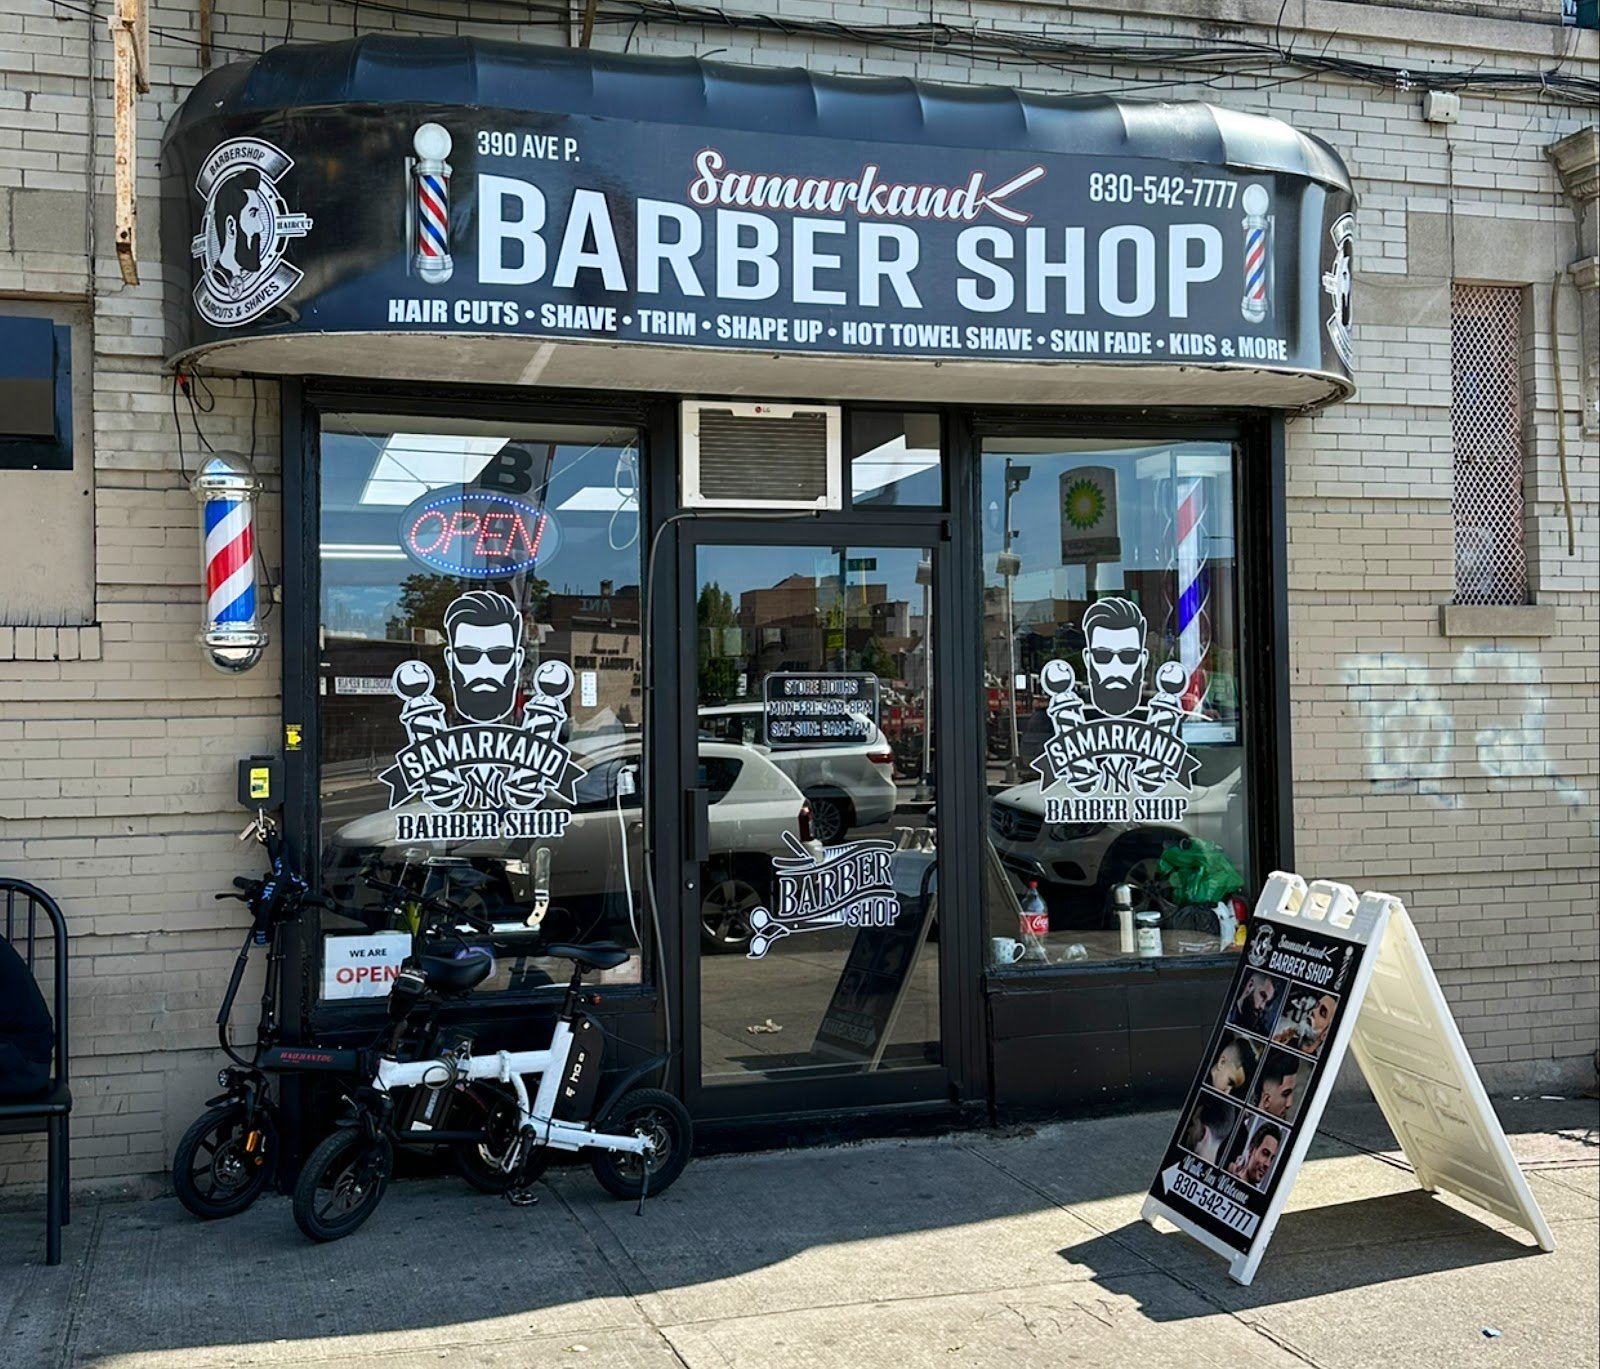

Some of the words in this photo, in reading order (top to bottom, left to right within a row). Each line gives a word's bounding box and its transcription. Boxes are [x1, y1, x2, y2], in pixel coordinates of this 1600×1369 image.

[209, 147, 265, 176] BARBERSHOP
[478, 130, 517, 157] 390
[522, 134, 559, 160] AVE
[564, 137, 580, 162] P.
[688, 150, 986, 220] Samarkand
[1089, 172, 1239, 209] 830-542-7777
[276, 220, 312, 230] HAIRCUT
[478, 173, 923, 309] BARBER
[955, 223, 1223, 319] SHOP
[235, 306, 242, 317] &
[244, 281, 280, 314] SHAVES
[388, 299, 448, 323] HAIR
[454, 300, 519, 326] CUTS
[540, 304, 617, 332] SHAVE
[637, 309, 697, 336] TRIM
[716, 314, 789, 342] SHAPE
[793, 317, 823, 343] UP
[842, 322, 886, 346] HOT
[890, 323, 962, 349] TOWEL
[966, 325, 1032, 350] SHAVE
[1050, 329, 1100, 353] SKIN
[1103, 330, 1152, 354] FADE
[1169, 333, 1216, 357] KIDS
[1220, 338, 1236, 357] &
[1238, 337, 1289, 361] MORE
[410, 510, 548, 557] OPEN
[784, 679, 820, 695] STORE
[820, 679, 859, 695] HOURS
[402, 731, 563, 779] SAMARKAND
[1051, 724, 1182, 767] SAMARKAND
[396, 811, 500, 842] BARBER
[504, 809, 572, 839] SHOP
[1045, 797, 1130, 823] BARBER
[1133, 796, 1189, 823] SHOP
[778, 851, 893, 917] BARBER
[848, 899, 900, 926] SHOP
[349, 949, 366, 958] WE
[367, 947, 387, 957] ARE
[1268, 950, 1307, 979] BARBER
[1304, 961, 1334, 986] SHOP
[336, 964, 400, 985] OPEN
[1172, 1173, 1254, 1232] 830-542-7777
